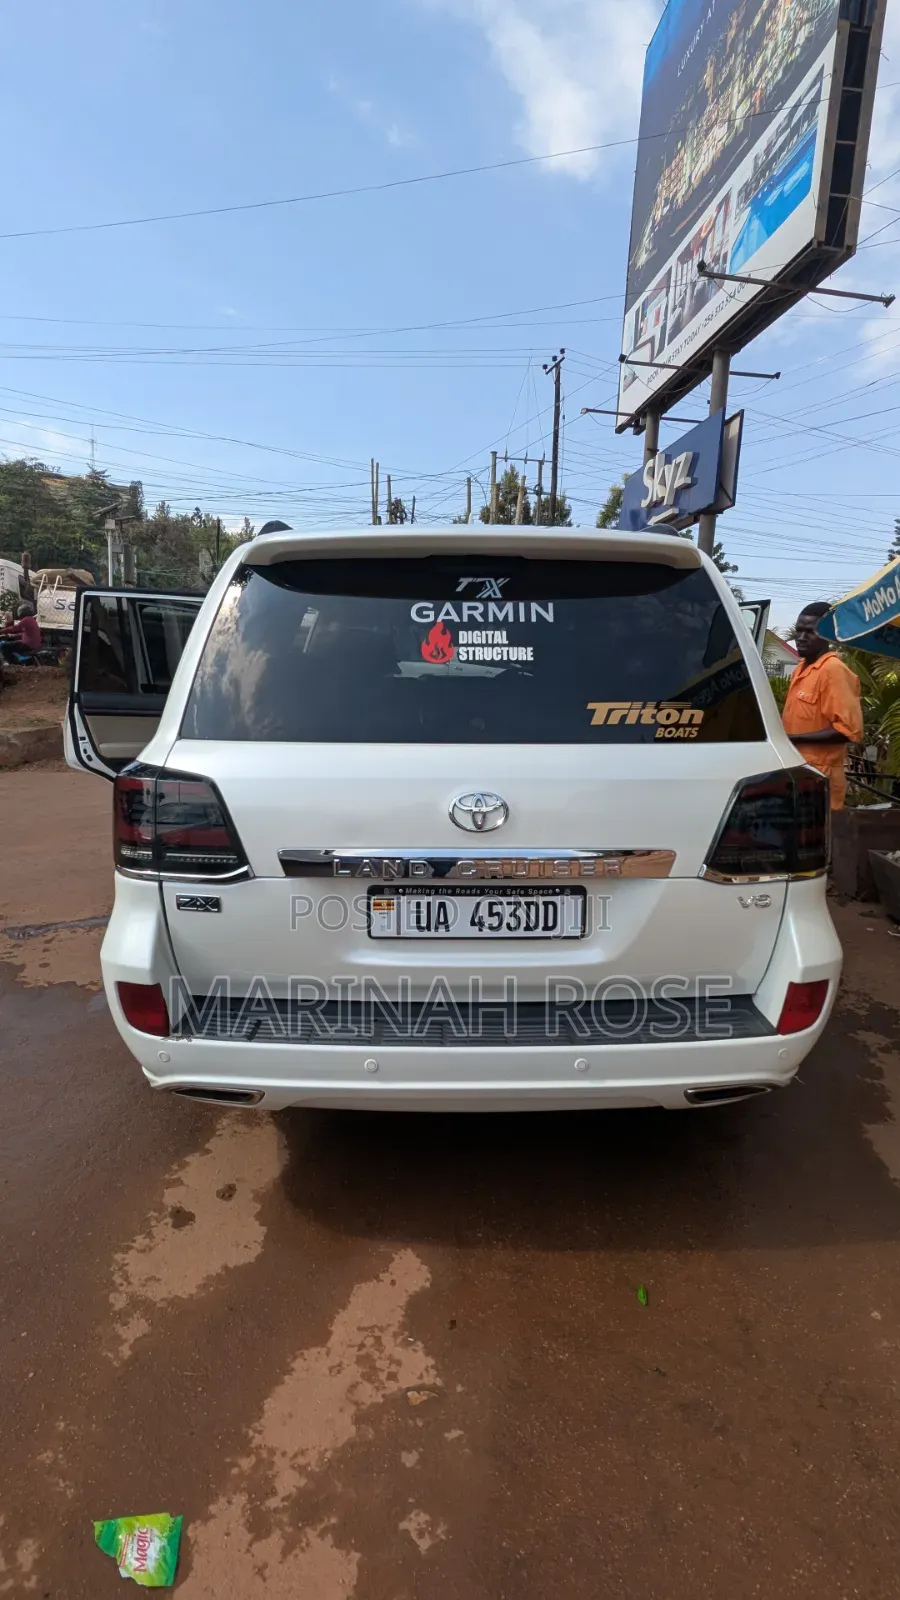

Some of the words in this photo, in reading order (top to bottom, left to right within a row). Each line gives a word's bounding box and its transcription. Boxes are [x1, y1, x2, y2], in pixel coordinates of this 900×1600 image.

[671, 340, 684, 361] STAY
[683, 324, 701, 348] TODAY
[410, 601, 554, 623] GARMIN
[862, 587, 897, 622] MoMo
[458, 630, 509, 645] DIGITAL
[458, 646, 534, 661] STRUCTURE
[586, 701, 705, 725] Triton
[655, 727, 699, 738] BOATS
[333, 858, 429, 878] LAND
[456, 858, 625, 878] CRUISER
[405, 887, 435, 896] Making
[438, 887, 453, 895] the
[528, 888, 553, 896] Space
[737, 894, 771, 909] V8
[415, 901, 451, 932] UA
[469, 901, 558, 932] 453DD
[133, 1526, 151, 1573] Magic
